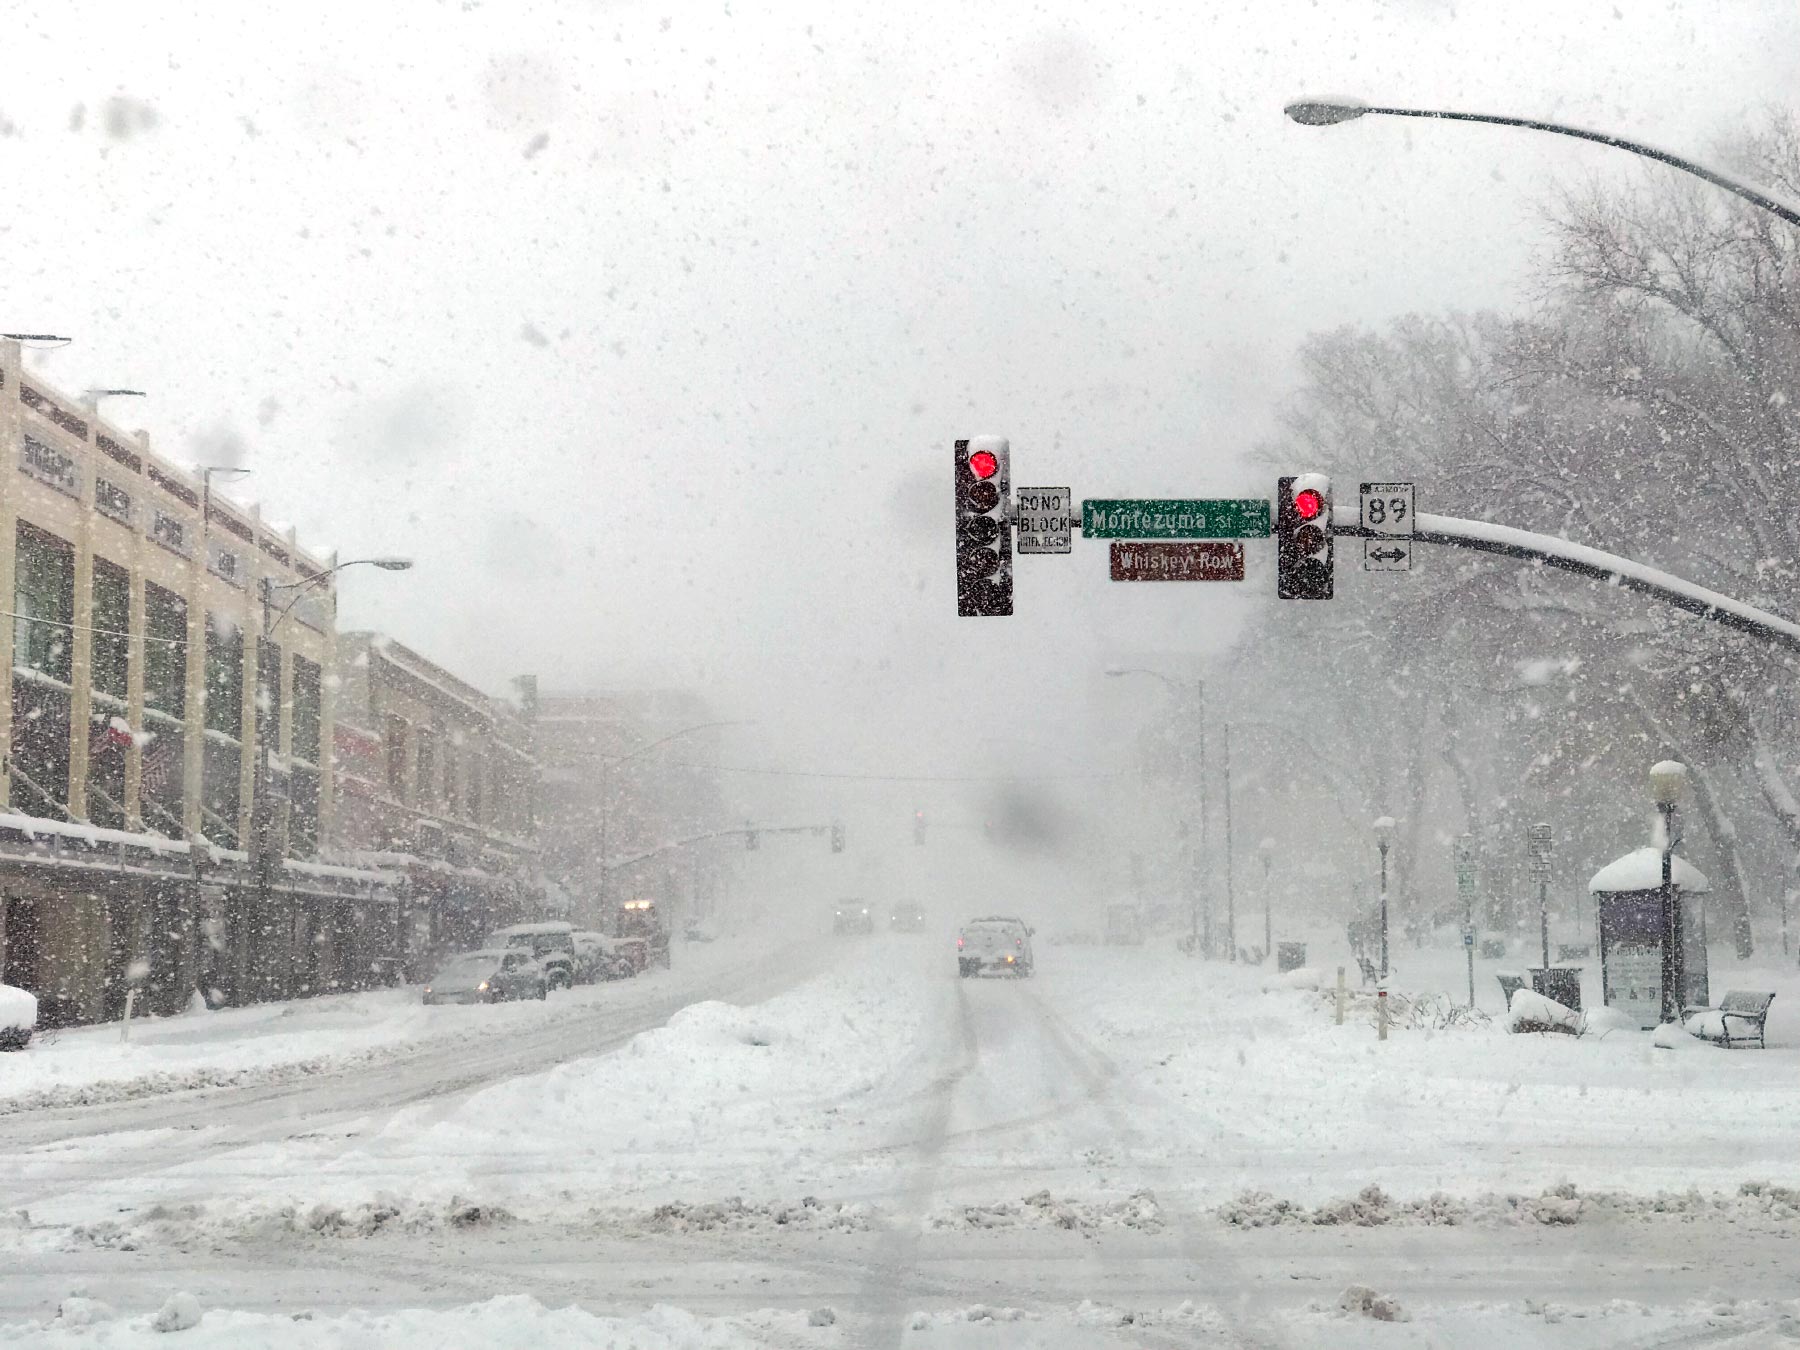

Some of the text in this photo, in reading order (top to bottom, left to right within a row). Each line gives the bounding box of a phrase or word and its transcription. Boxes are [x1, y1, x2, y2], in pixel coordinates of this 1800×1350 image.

[1020, 495, 1068, 511] DO NO
[1368, 497, 1407, 525] 89
[1020, 516, 1068, 533] BLOCK
[1091, 509, 1232, 529] Montezuma St
[1020, 536, 1069, 547] INTERECION
[1120, 551, 1234, 574] Whiskey Row
